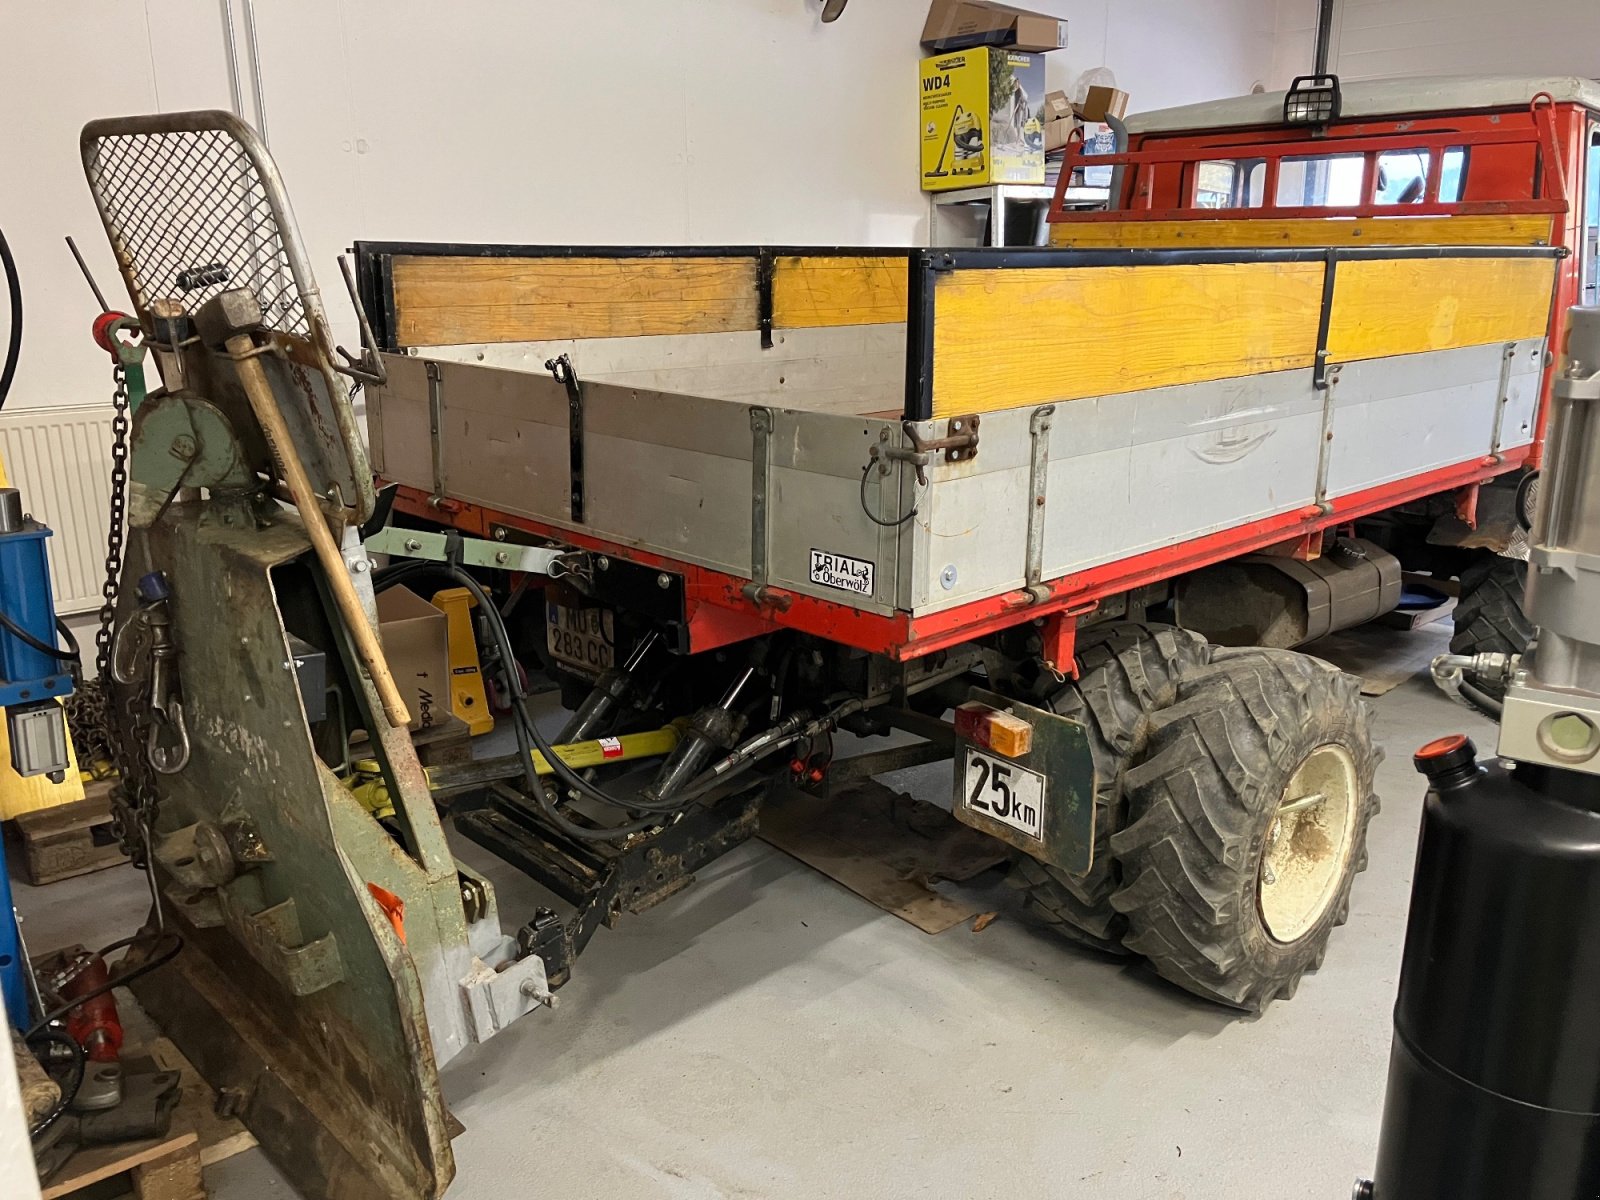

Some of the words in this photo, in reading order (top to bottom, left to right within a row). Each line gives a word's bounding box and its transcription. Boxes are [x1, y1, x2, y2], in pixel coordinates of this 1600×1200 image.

[813, 552, 858, 577] TRIAL
[822, 571, 868, 592] Oberwölz
[553, 628, 583, 660] 283
